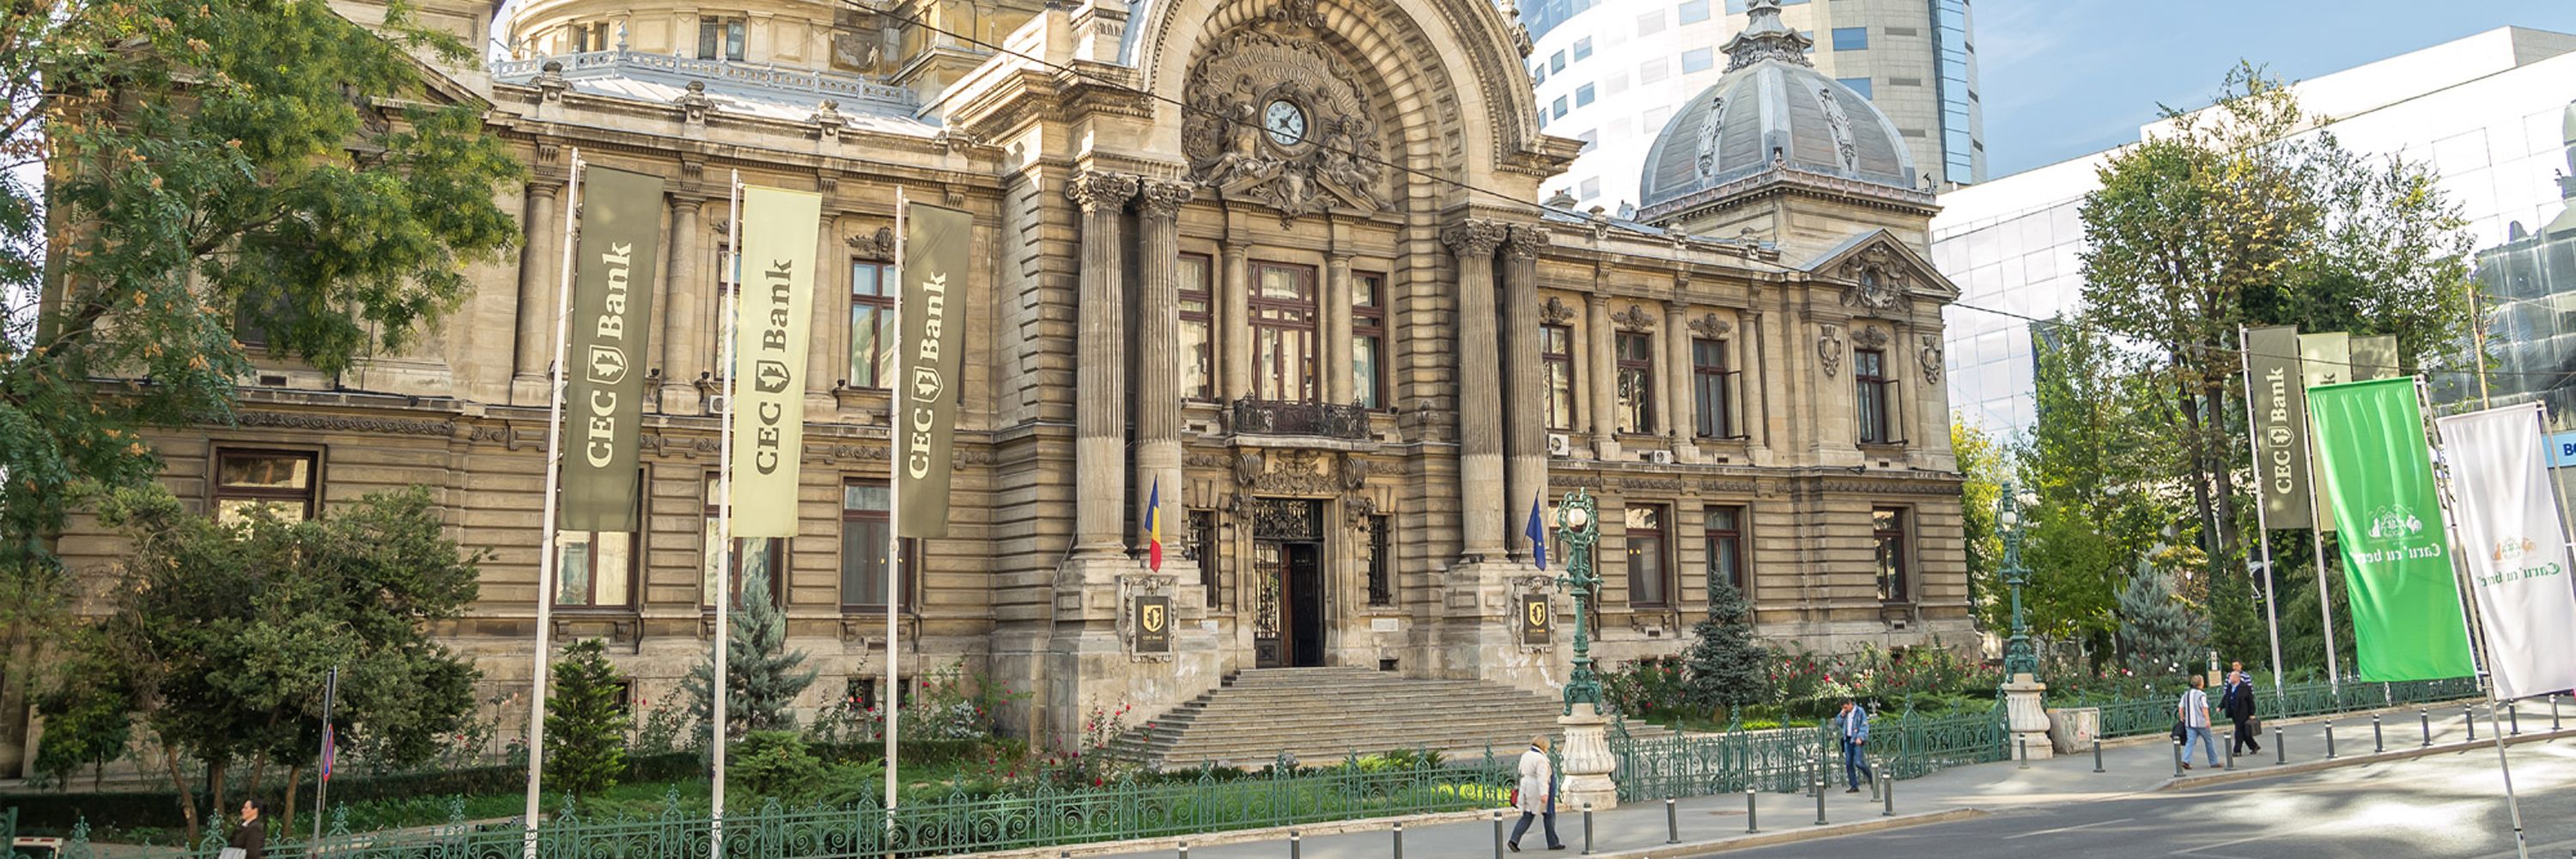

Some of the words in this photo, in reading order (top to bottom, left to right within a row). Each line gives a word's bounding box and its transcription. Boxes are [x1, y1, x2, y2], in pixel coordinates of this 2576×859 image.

[597, 241, 632, 340] Bank
[762, 259, 792, 353] Bank
[920, 271, 946, 362] Bank
[586, 390, 617, 468] CEC
[2266, 366, 2287, 423] Bank
[756, 401, 781, 475] CEC
[909, 408, 933, 479] CEC
[2274, 450, 2293, 494] CEC
[2562, 442, 2576, 456] B
